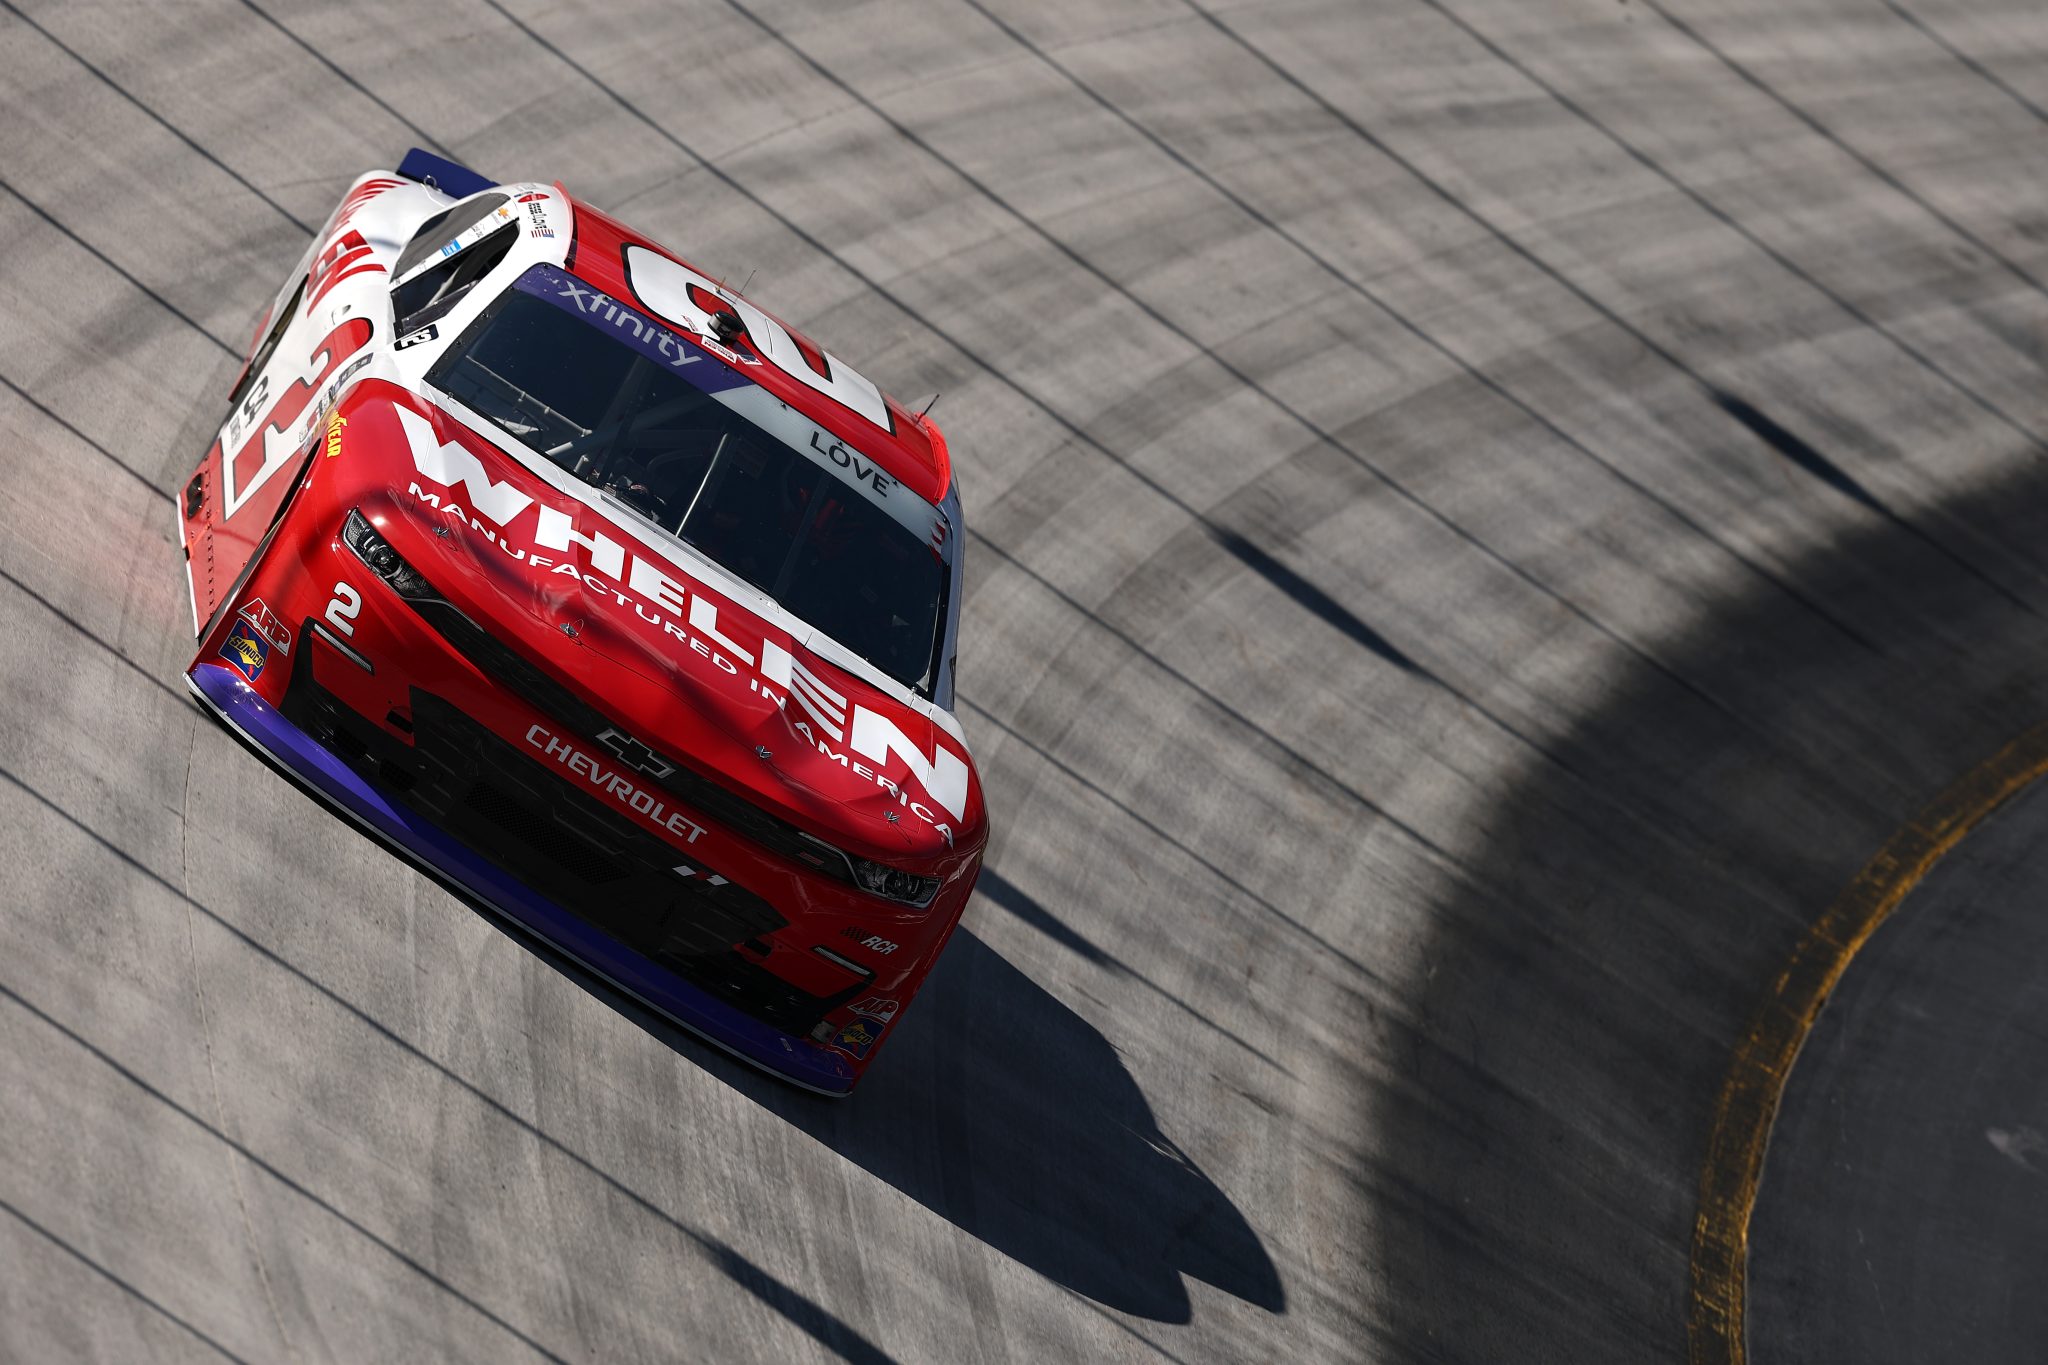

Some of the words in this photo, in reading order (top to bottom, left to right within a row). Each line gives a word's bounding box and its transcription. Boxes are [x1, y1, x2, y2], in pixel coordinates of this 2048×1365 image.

[558, 280, 702, 367] xfinity
[810, 431, 888, 499] LOVE
[238, 598, 291, 656] ARP
[324, 580, 362, 638] 2
[392, 400, 969, 824] WHELEN
[229, 635, 265, 669] SUNOCO
[407, 481, 738, 676] MANUFACTURED
[749, 678, 787, 712] IN
[794, 721, 954, 850] AMERICA
[525, 724, 708, 844] CHEVROLET
[861, 935, 899, 955] RCR
